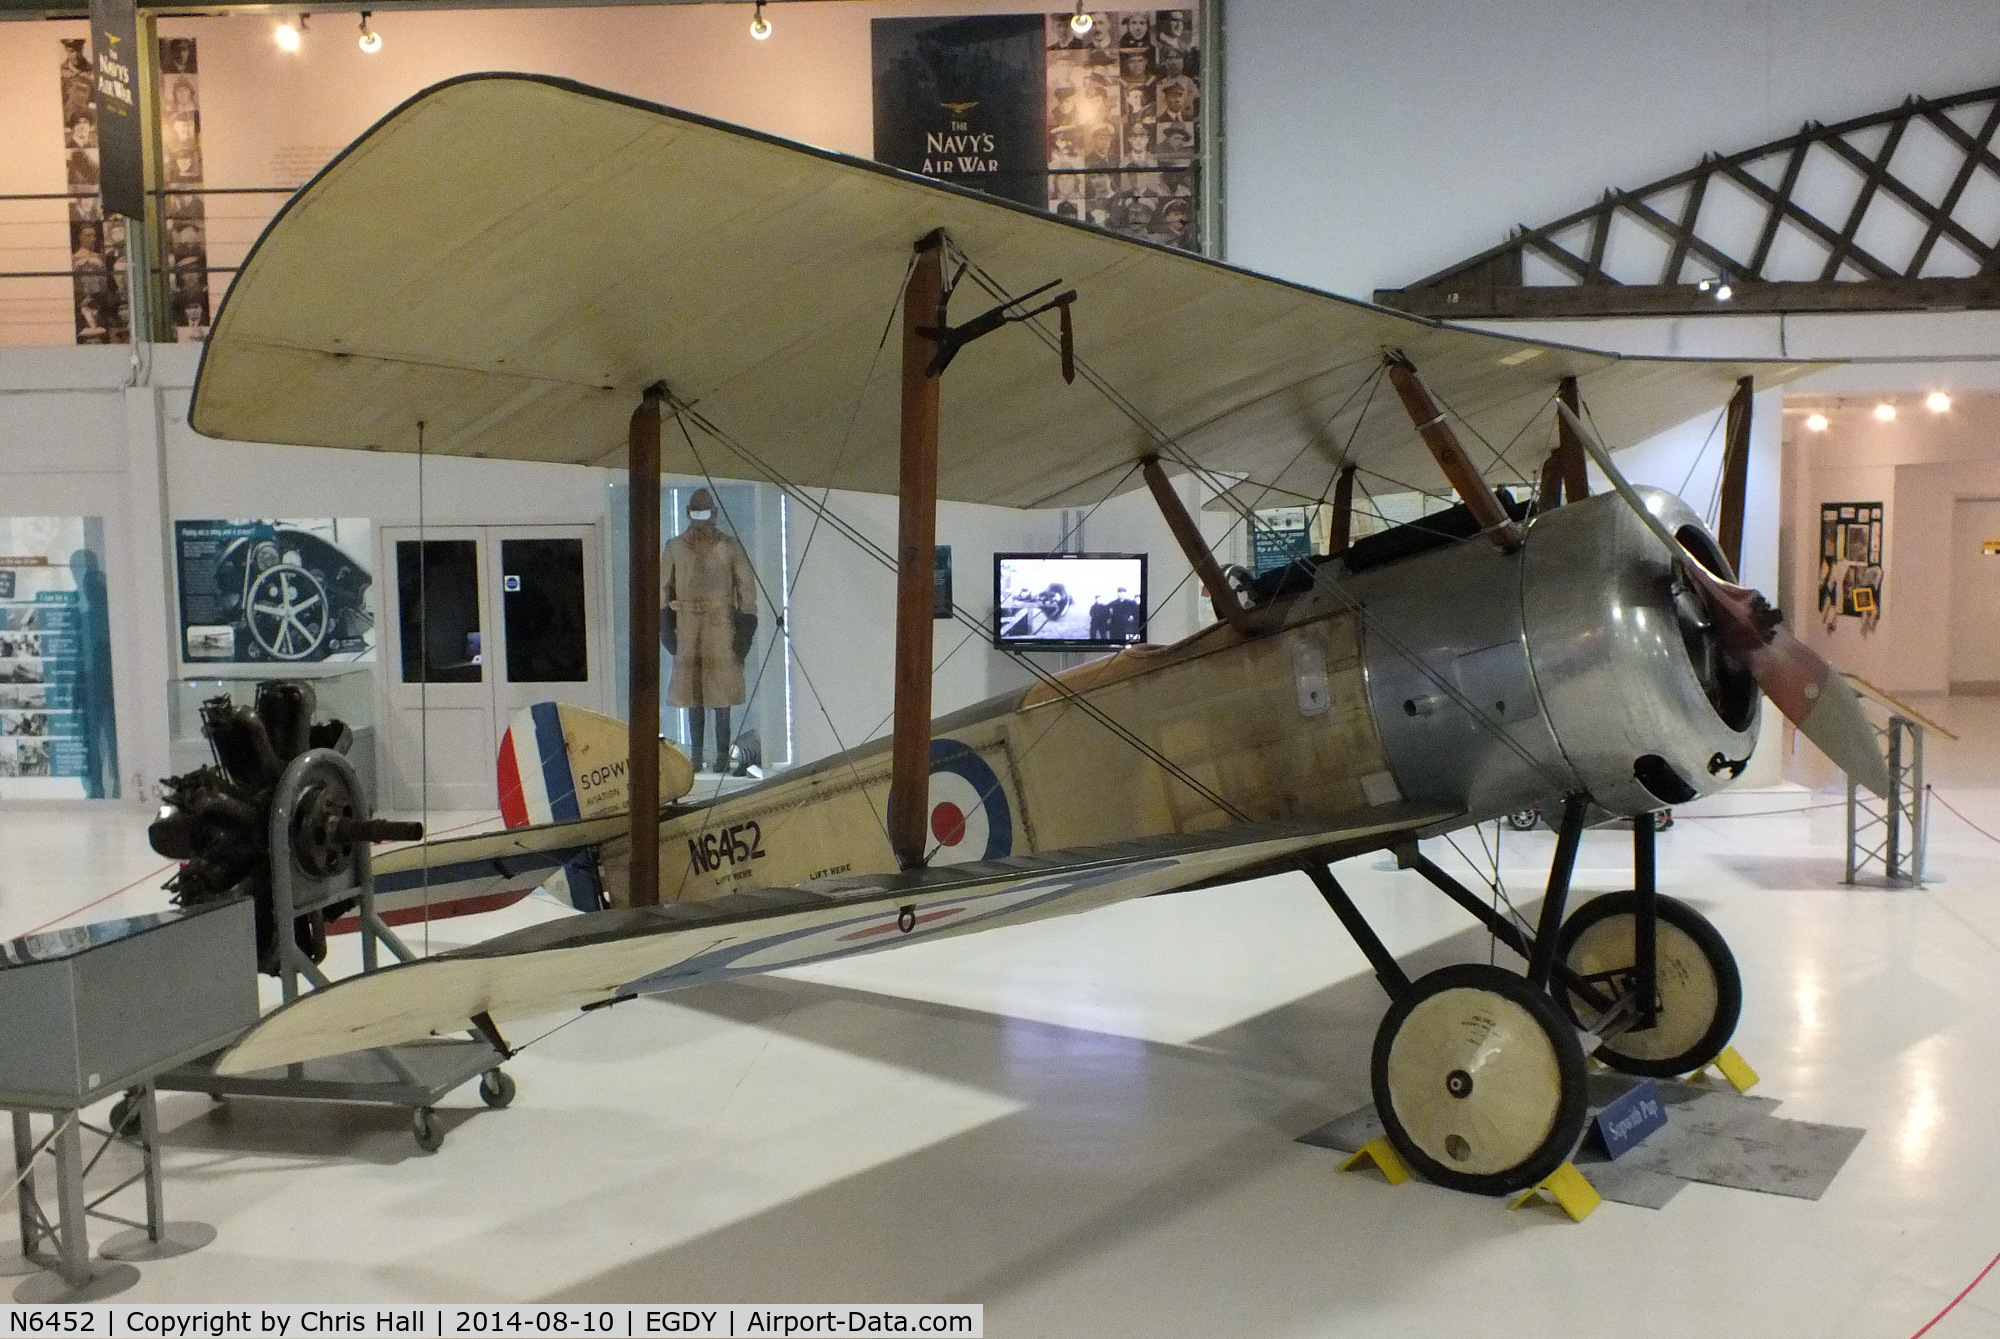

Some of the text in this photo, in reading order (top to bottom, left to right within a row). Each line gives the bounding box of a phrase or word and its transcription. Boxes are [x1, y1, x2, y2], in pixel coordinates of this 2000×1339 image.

[951, 121, 967, 131] THE
[927, 132, 995, 153] NAVY'S
[922, 157, 998, 173] AIR WAR
[688, 820, 766, 875] N6452
[715, 869, 753, 885] LIFT HERE
[810, 863, 852, 881] LIFT HERE
